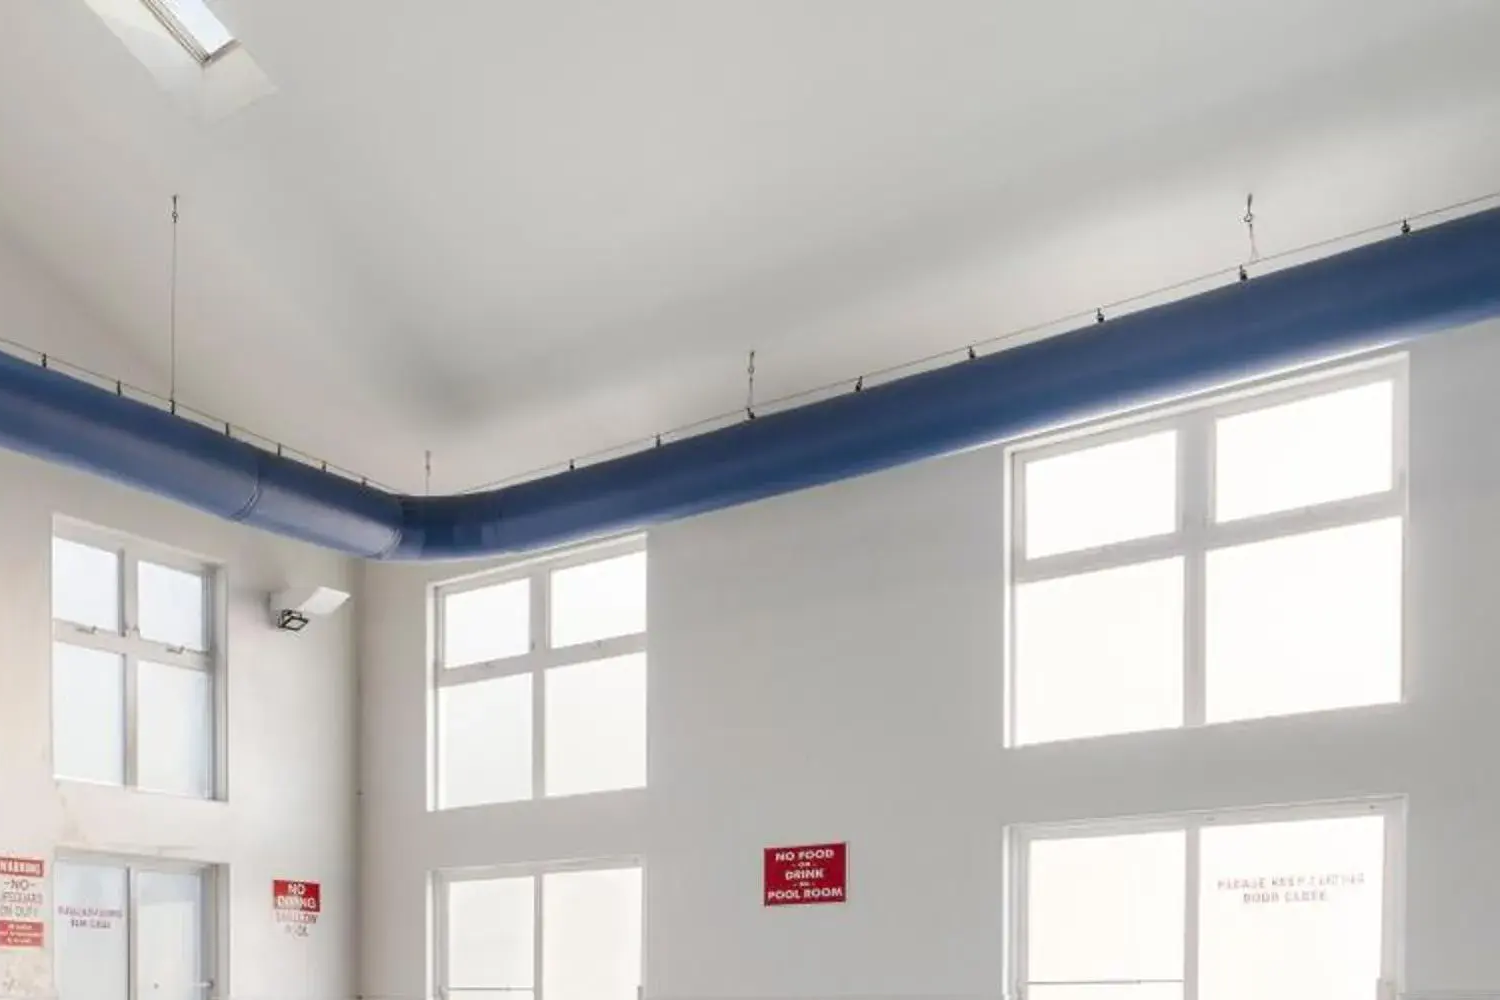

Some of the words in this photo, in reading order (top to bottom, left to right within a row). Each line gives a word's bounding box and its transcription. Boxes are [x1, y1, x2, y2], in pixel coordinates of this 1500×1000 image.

[775, 851, 795, 862] NO
[798, 849, 834, 860] FOOD
[767, 889, 801, 899] POOL
[804, 886, 843, 898] ROOM
